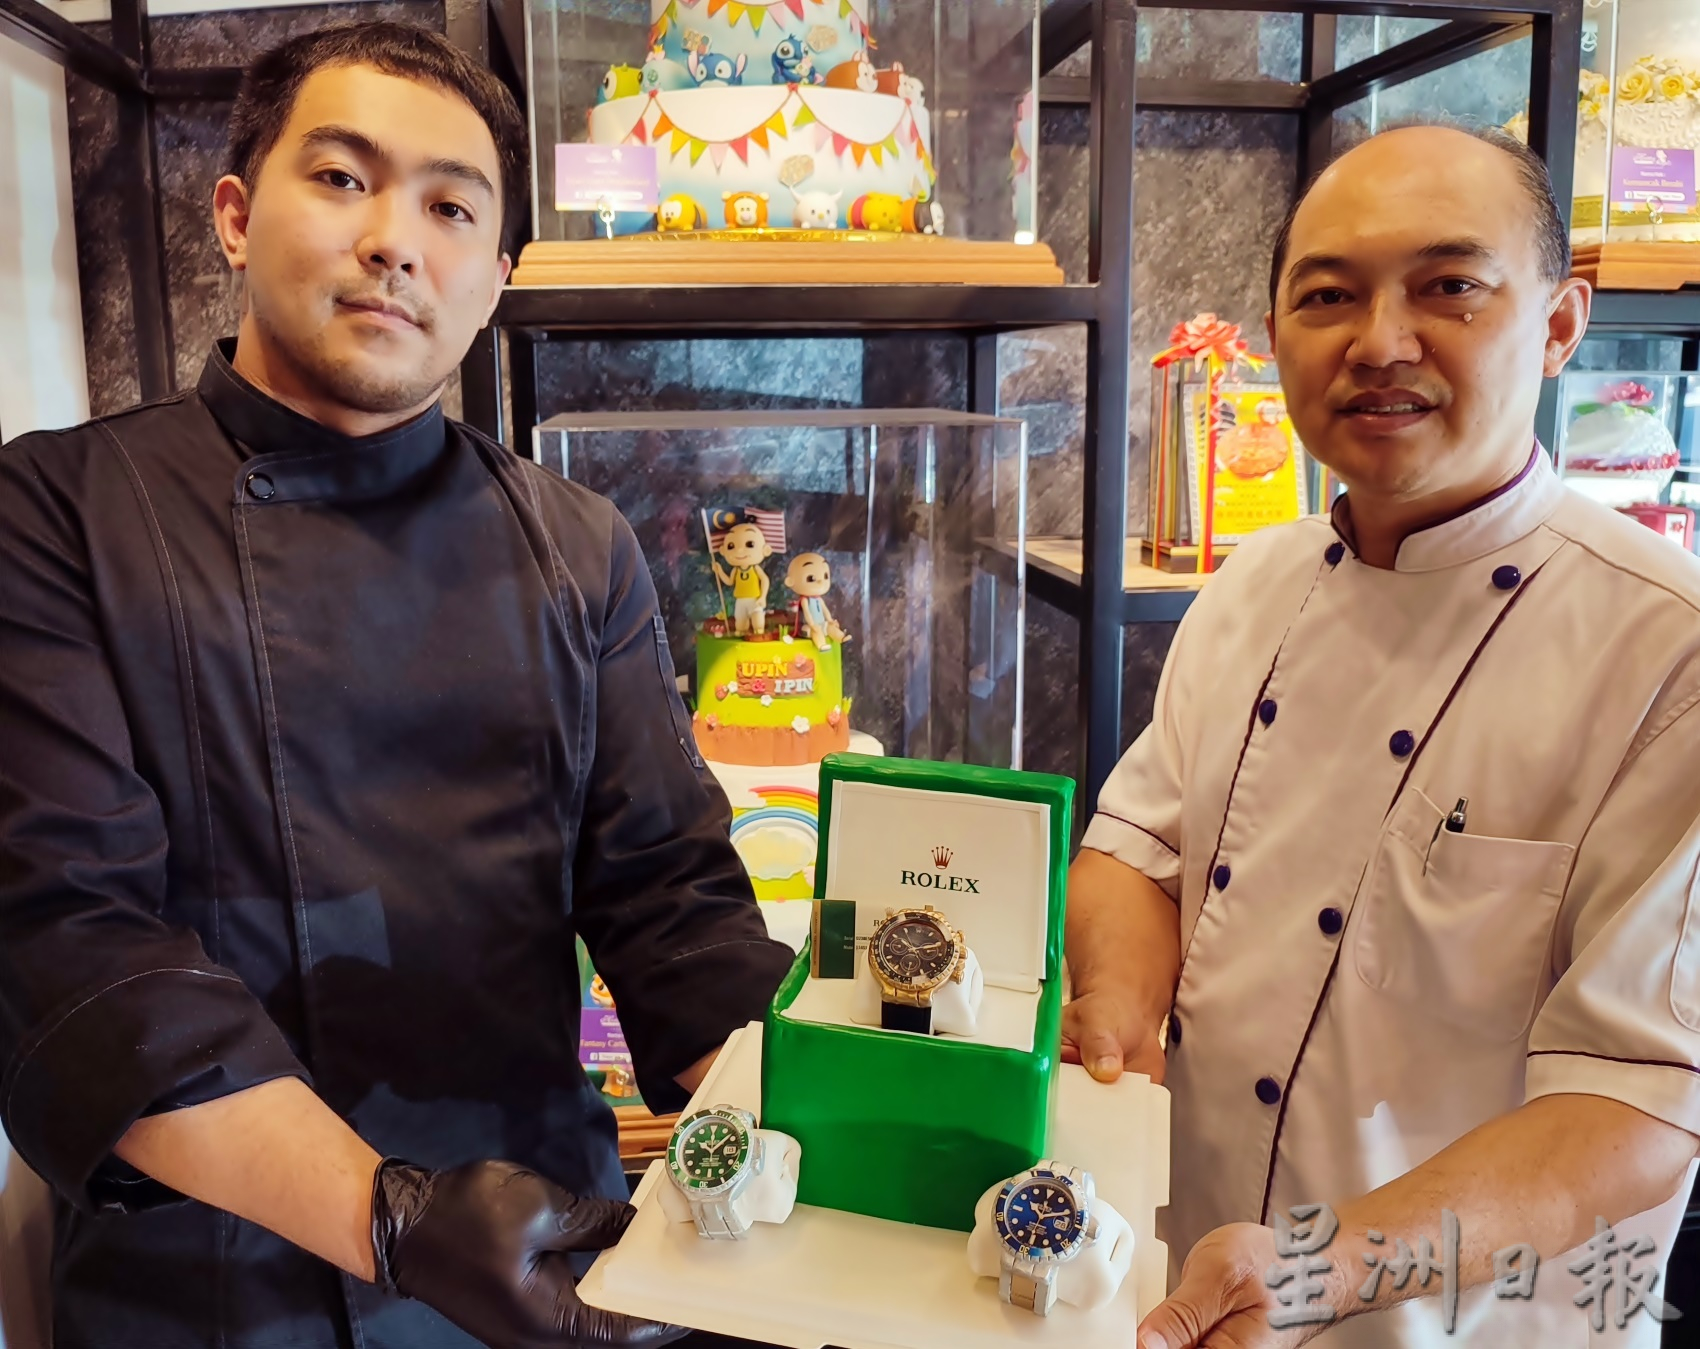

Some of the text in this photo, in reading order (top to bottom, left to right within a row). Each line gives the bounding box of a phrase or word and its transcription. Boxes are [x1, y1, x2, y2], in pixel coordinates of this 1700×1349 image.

[741, 662, 788, 678] UPIN
[752, 678, 814, 694] & IPIN
[901, 870, 980, 894] ROLEX
